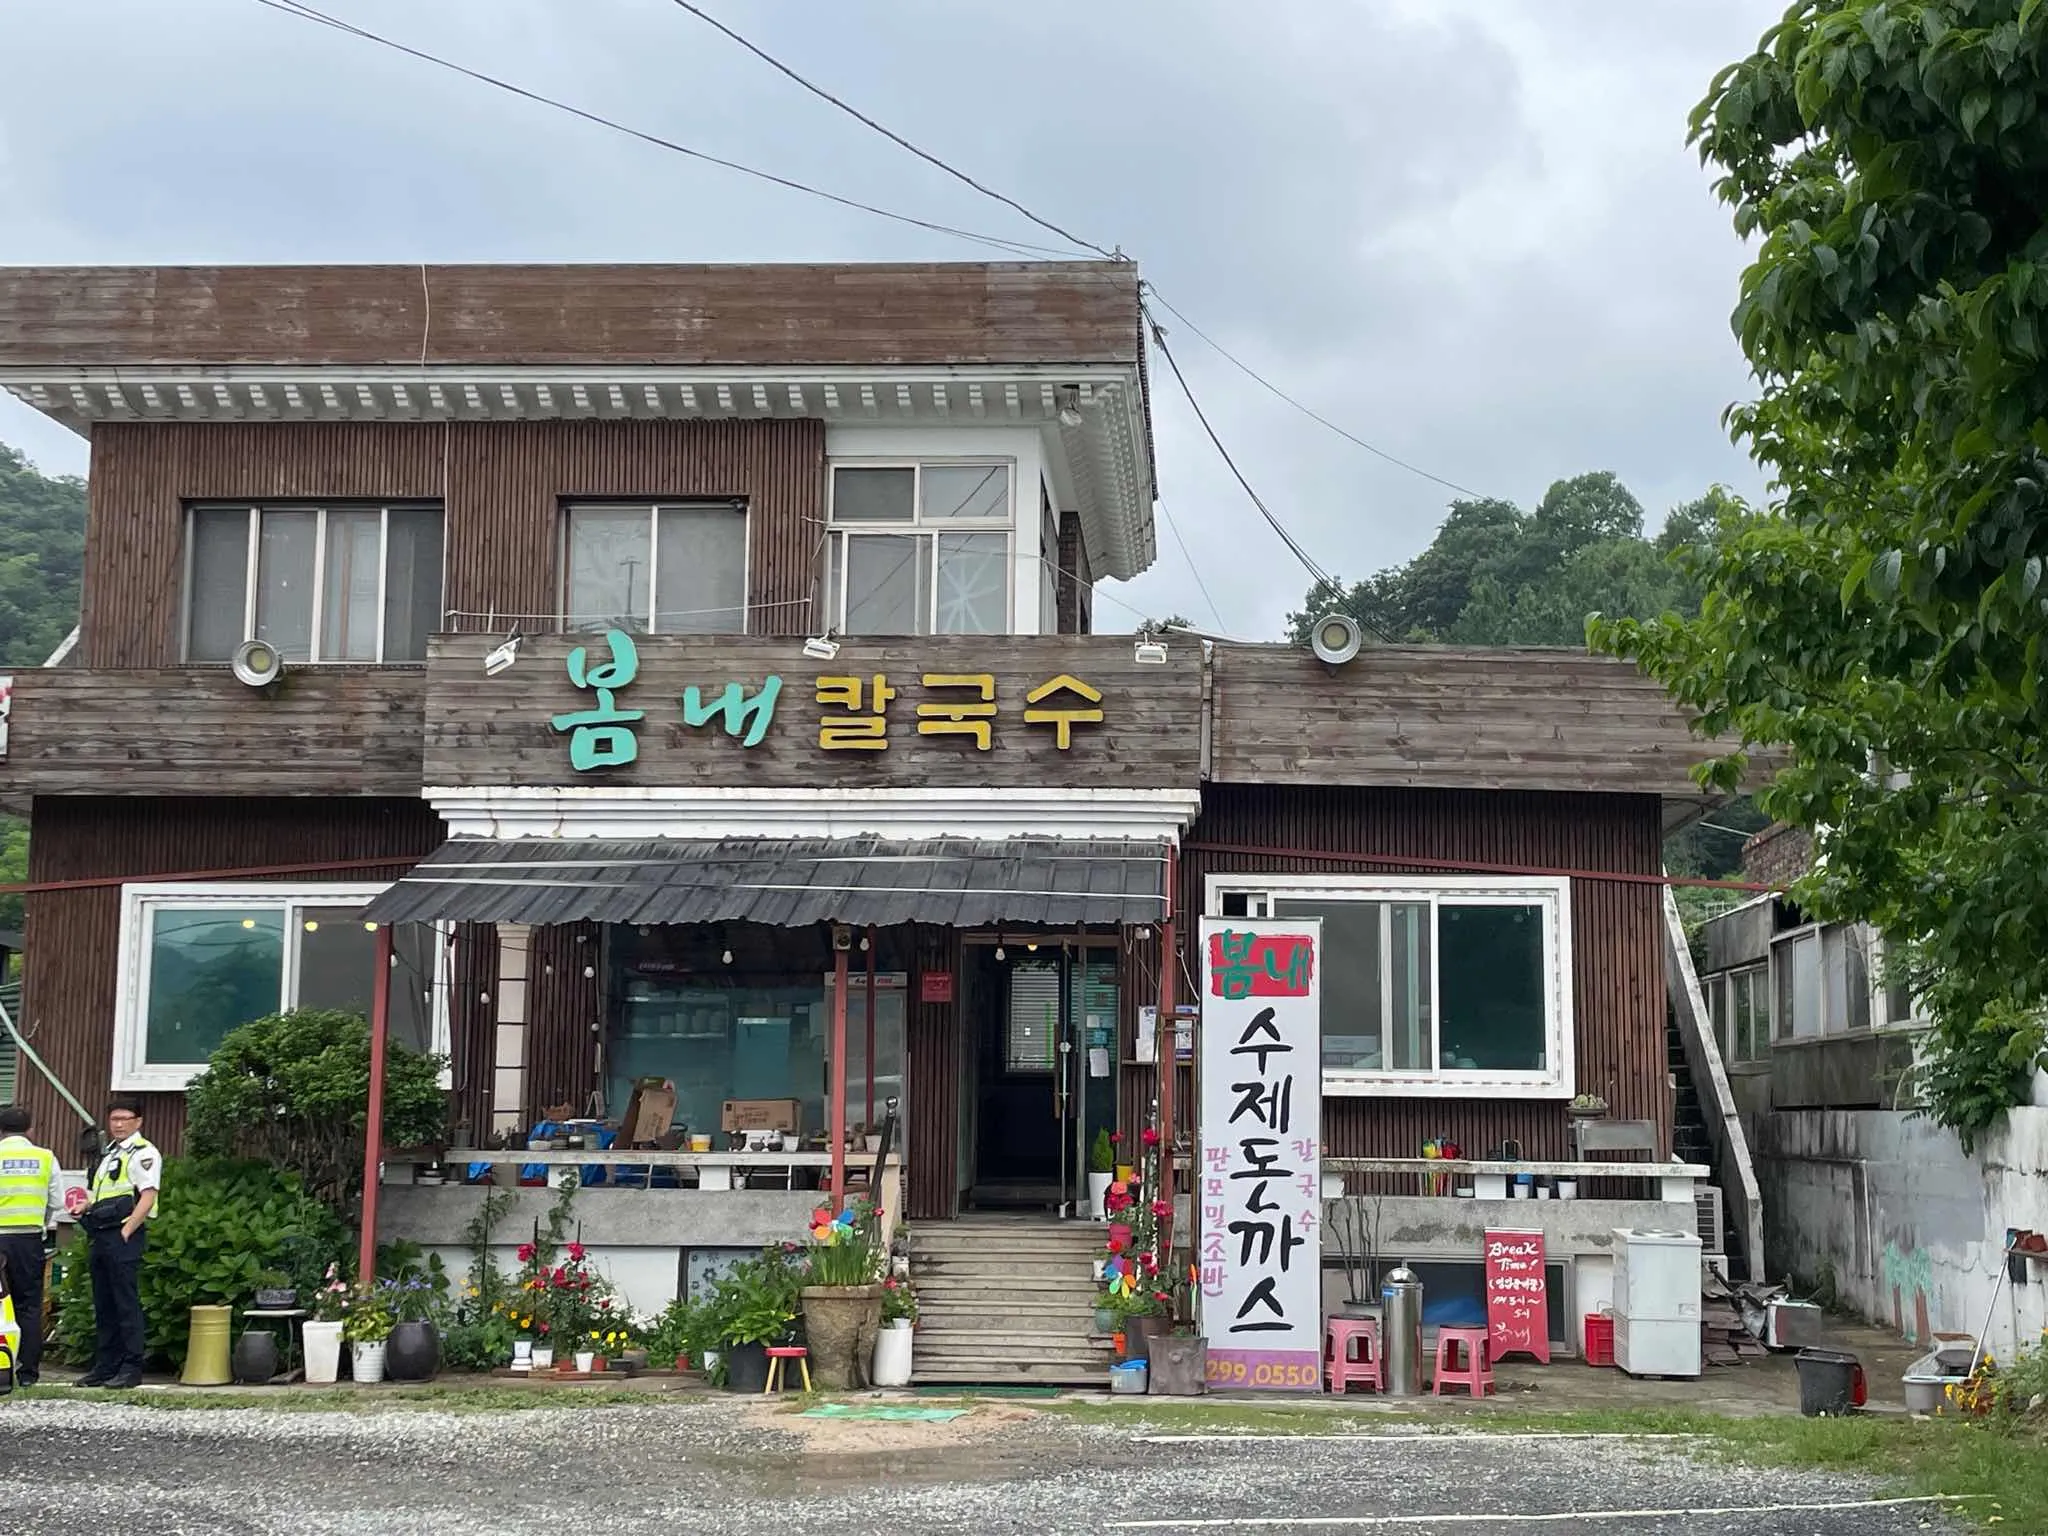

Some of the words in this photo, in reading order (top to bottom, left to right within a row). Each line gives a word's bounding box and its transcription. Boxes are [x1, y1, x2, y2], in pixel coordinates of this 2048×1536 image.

[552, 629, 783, 770] 봄내
[816, 672, 1104, 751] 칼국수
[1211, 929, 1311, 1000] 봄내
[1229, 1006, 1304, 1333] 수제돈까스
[1292, 1138, 1318, 1232] 칼국수
